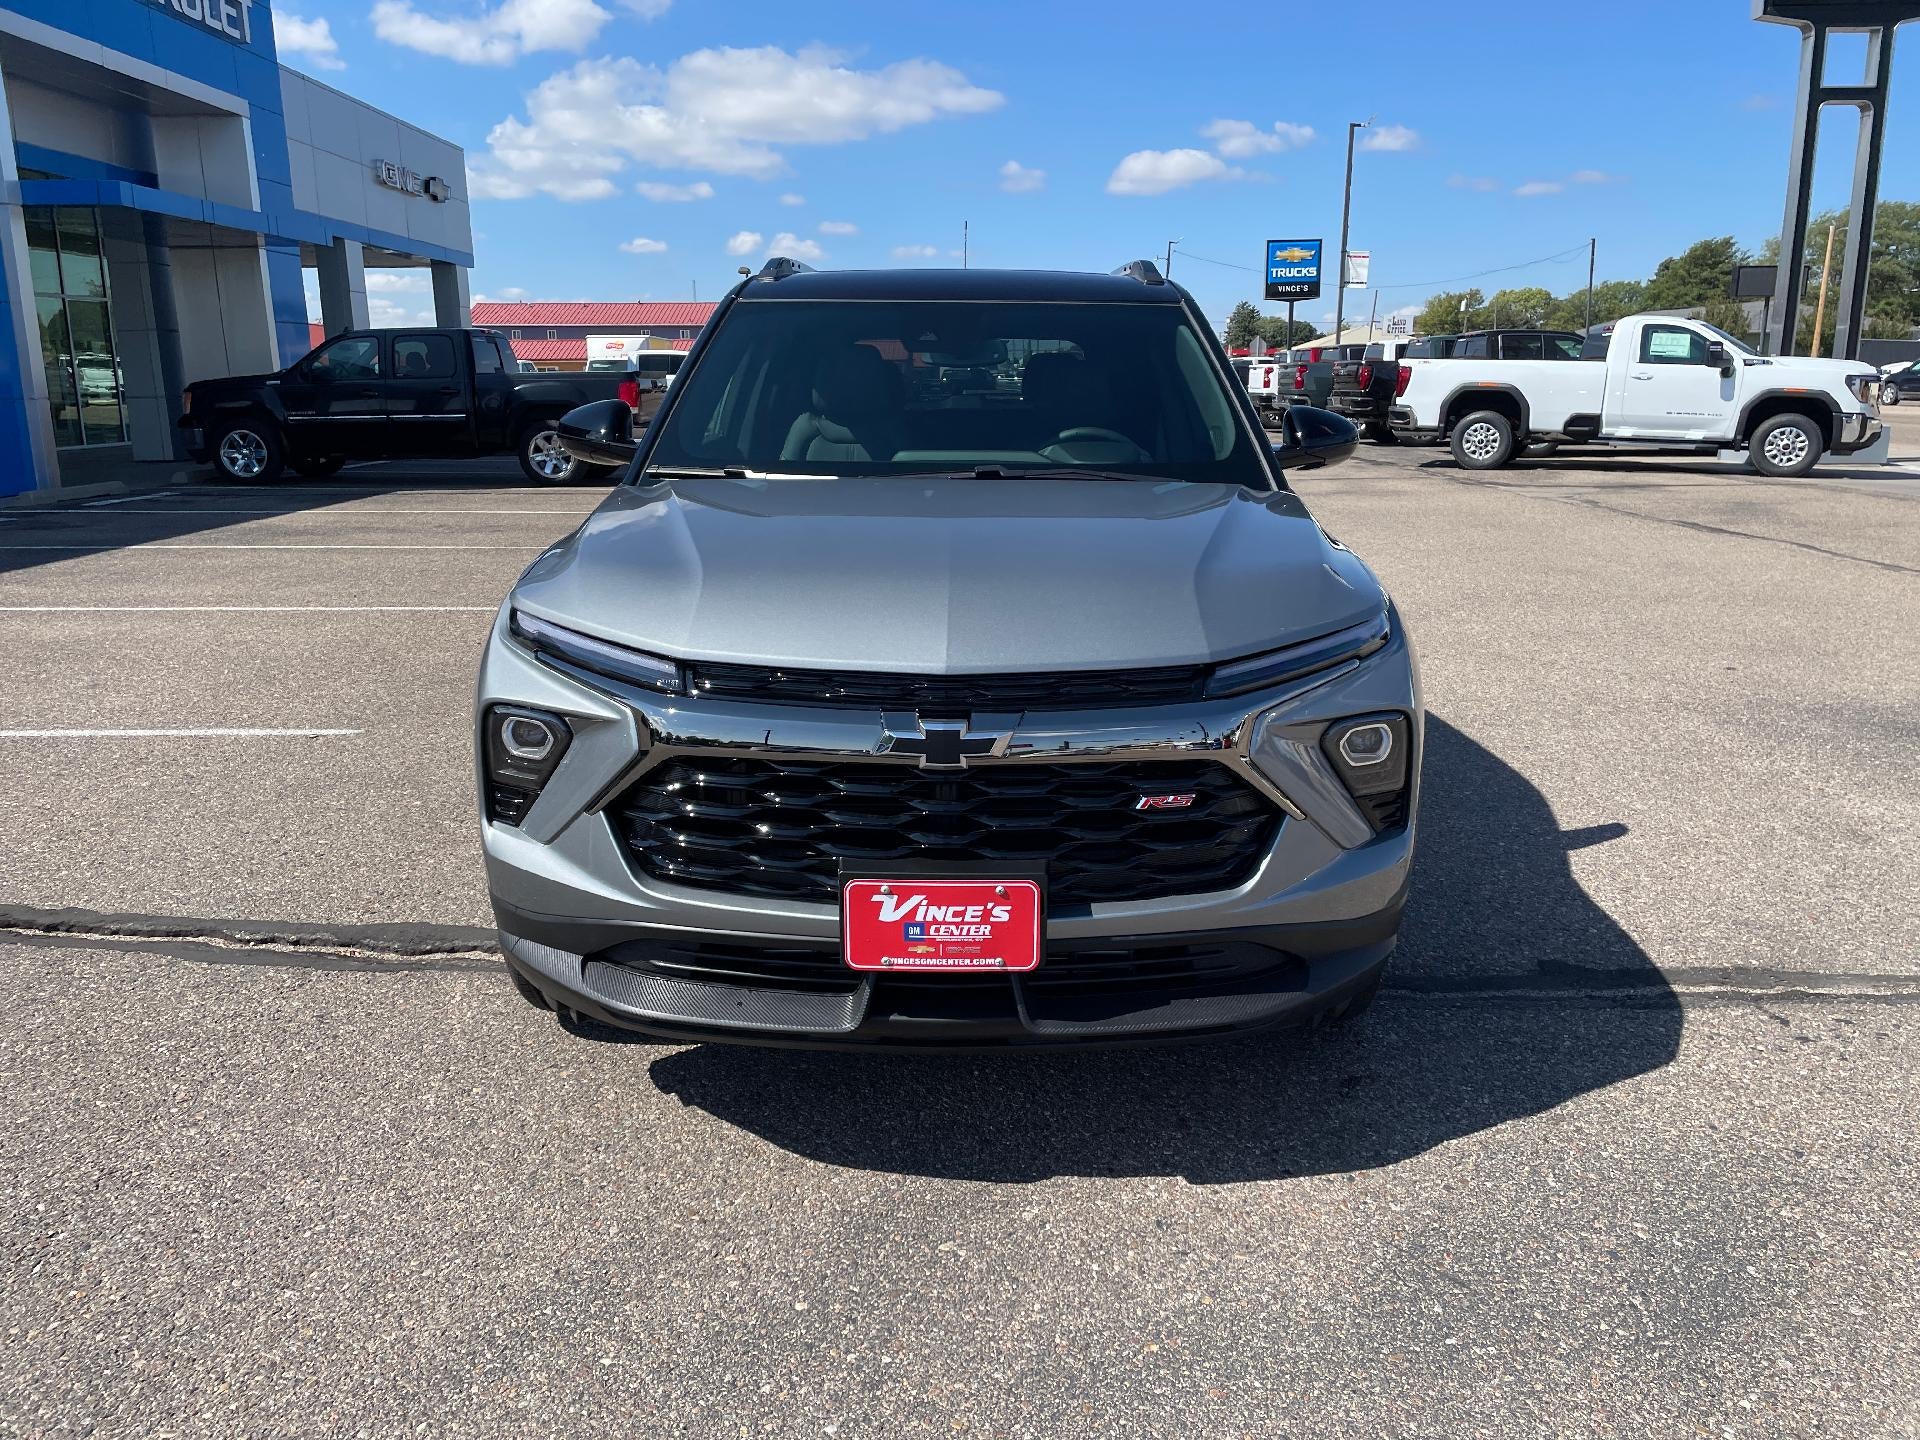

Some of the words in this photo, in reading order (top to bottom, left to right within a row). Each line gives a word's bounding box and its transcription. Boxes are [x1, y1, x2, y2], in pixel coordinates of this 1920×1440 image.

[379, 159, 424, 197] GMC
[1271, 267, 1317, 277] TRUCKS
[1278, 284, 1309, 293] VINCE'S
[1135, 794, 1196, 810] RS
[908, 926, 921, 935] GM
[929, 925, 992, 936] CENTER
